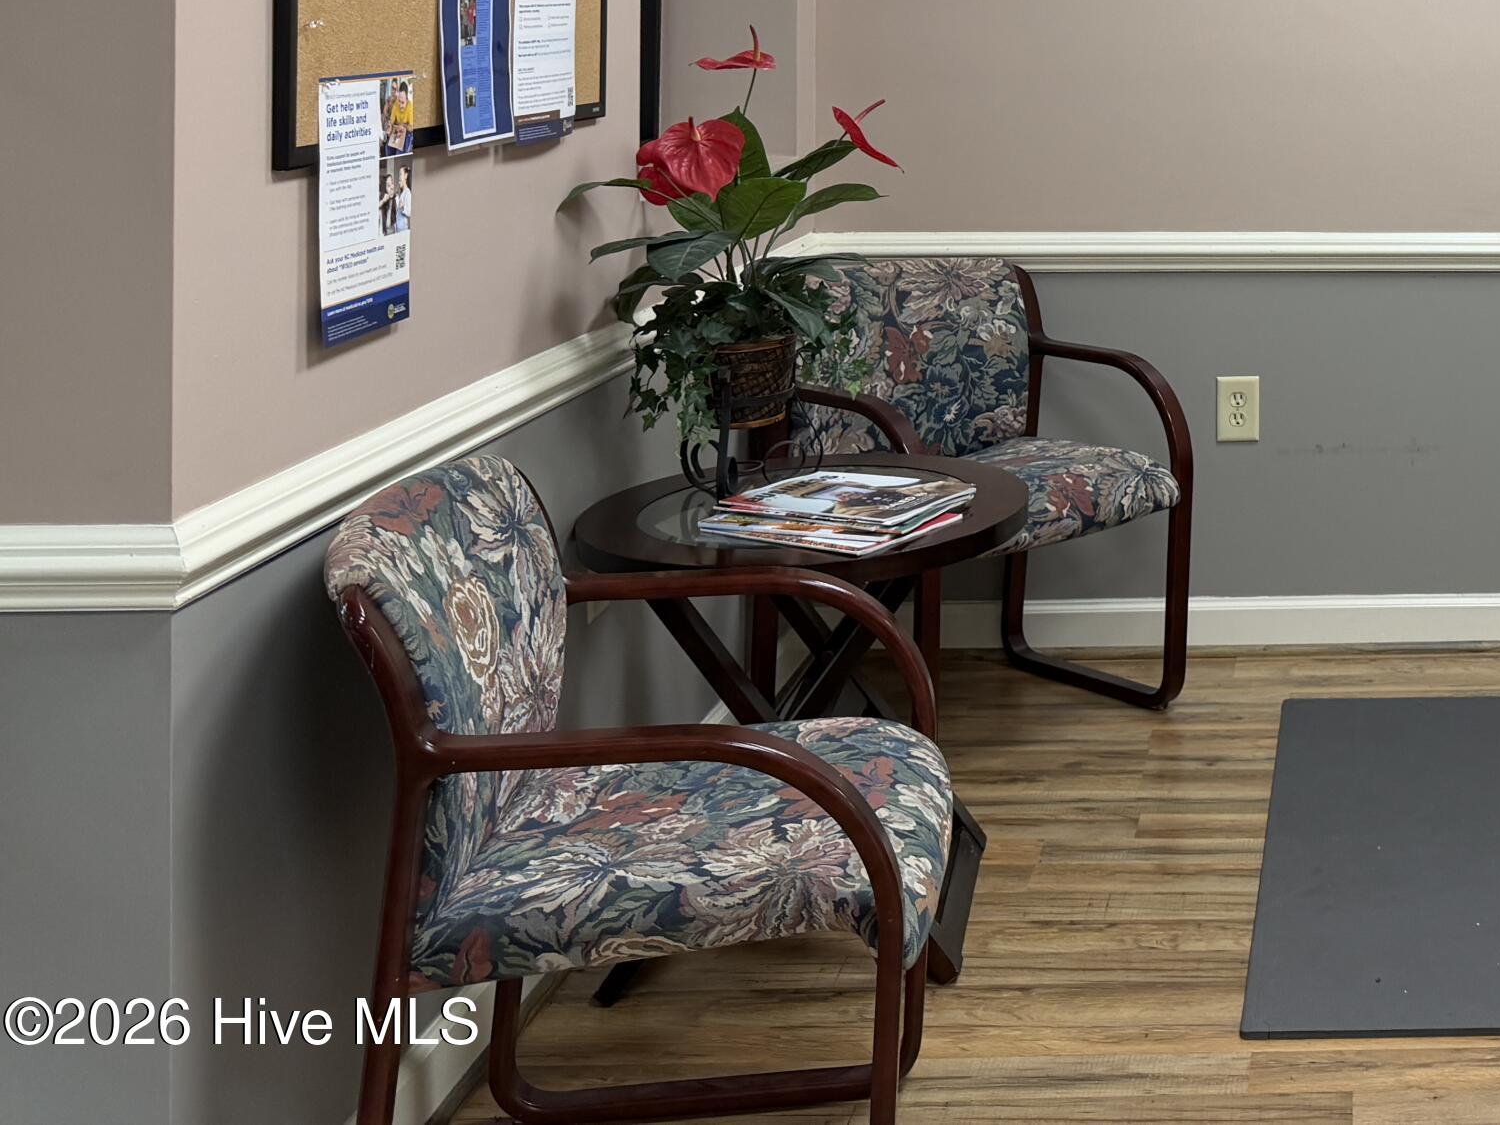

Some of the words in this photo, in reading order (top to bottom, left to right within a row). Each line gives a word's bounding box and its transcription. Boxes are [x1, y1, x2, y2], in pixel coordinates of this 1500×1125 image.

[326, 103, 338, 113] Get
[340, 101, 354, 113] help
[356, 99, 368, 110] with
[326, 117, 337, 127] life
[339, 115, 354, 127] skills
[356, 114, 367, 123] and
[326, 129, 343, 143] daily
[344, 127, 372, 139] activities
